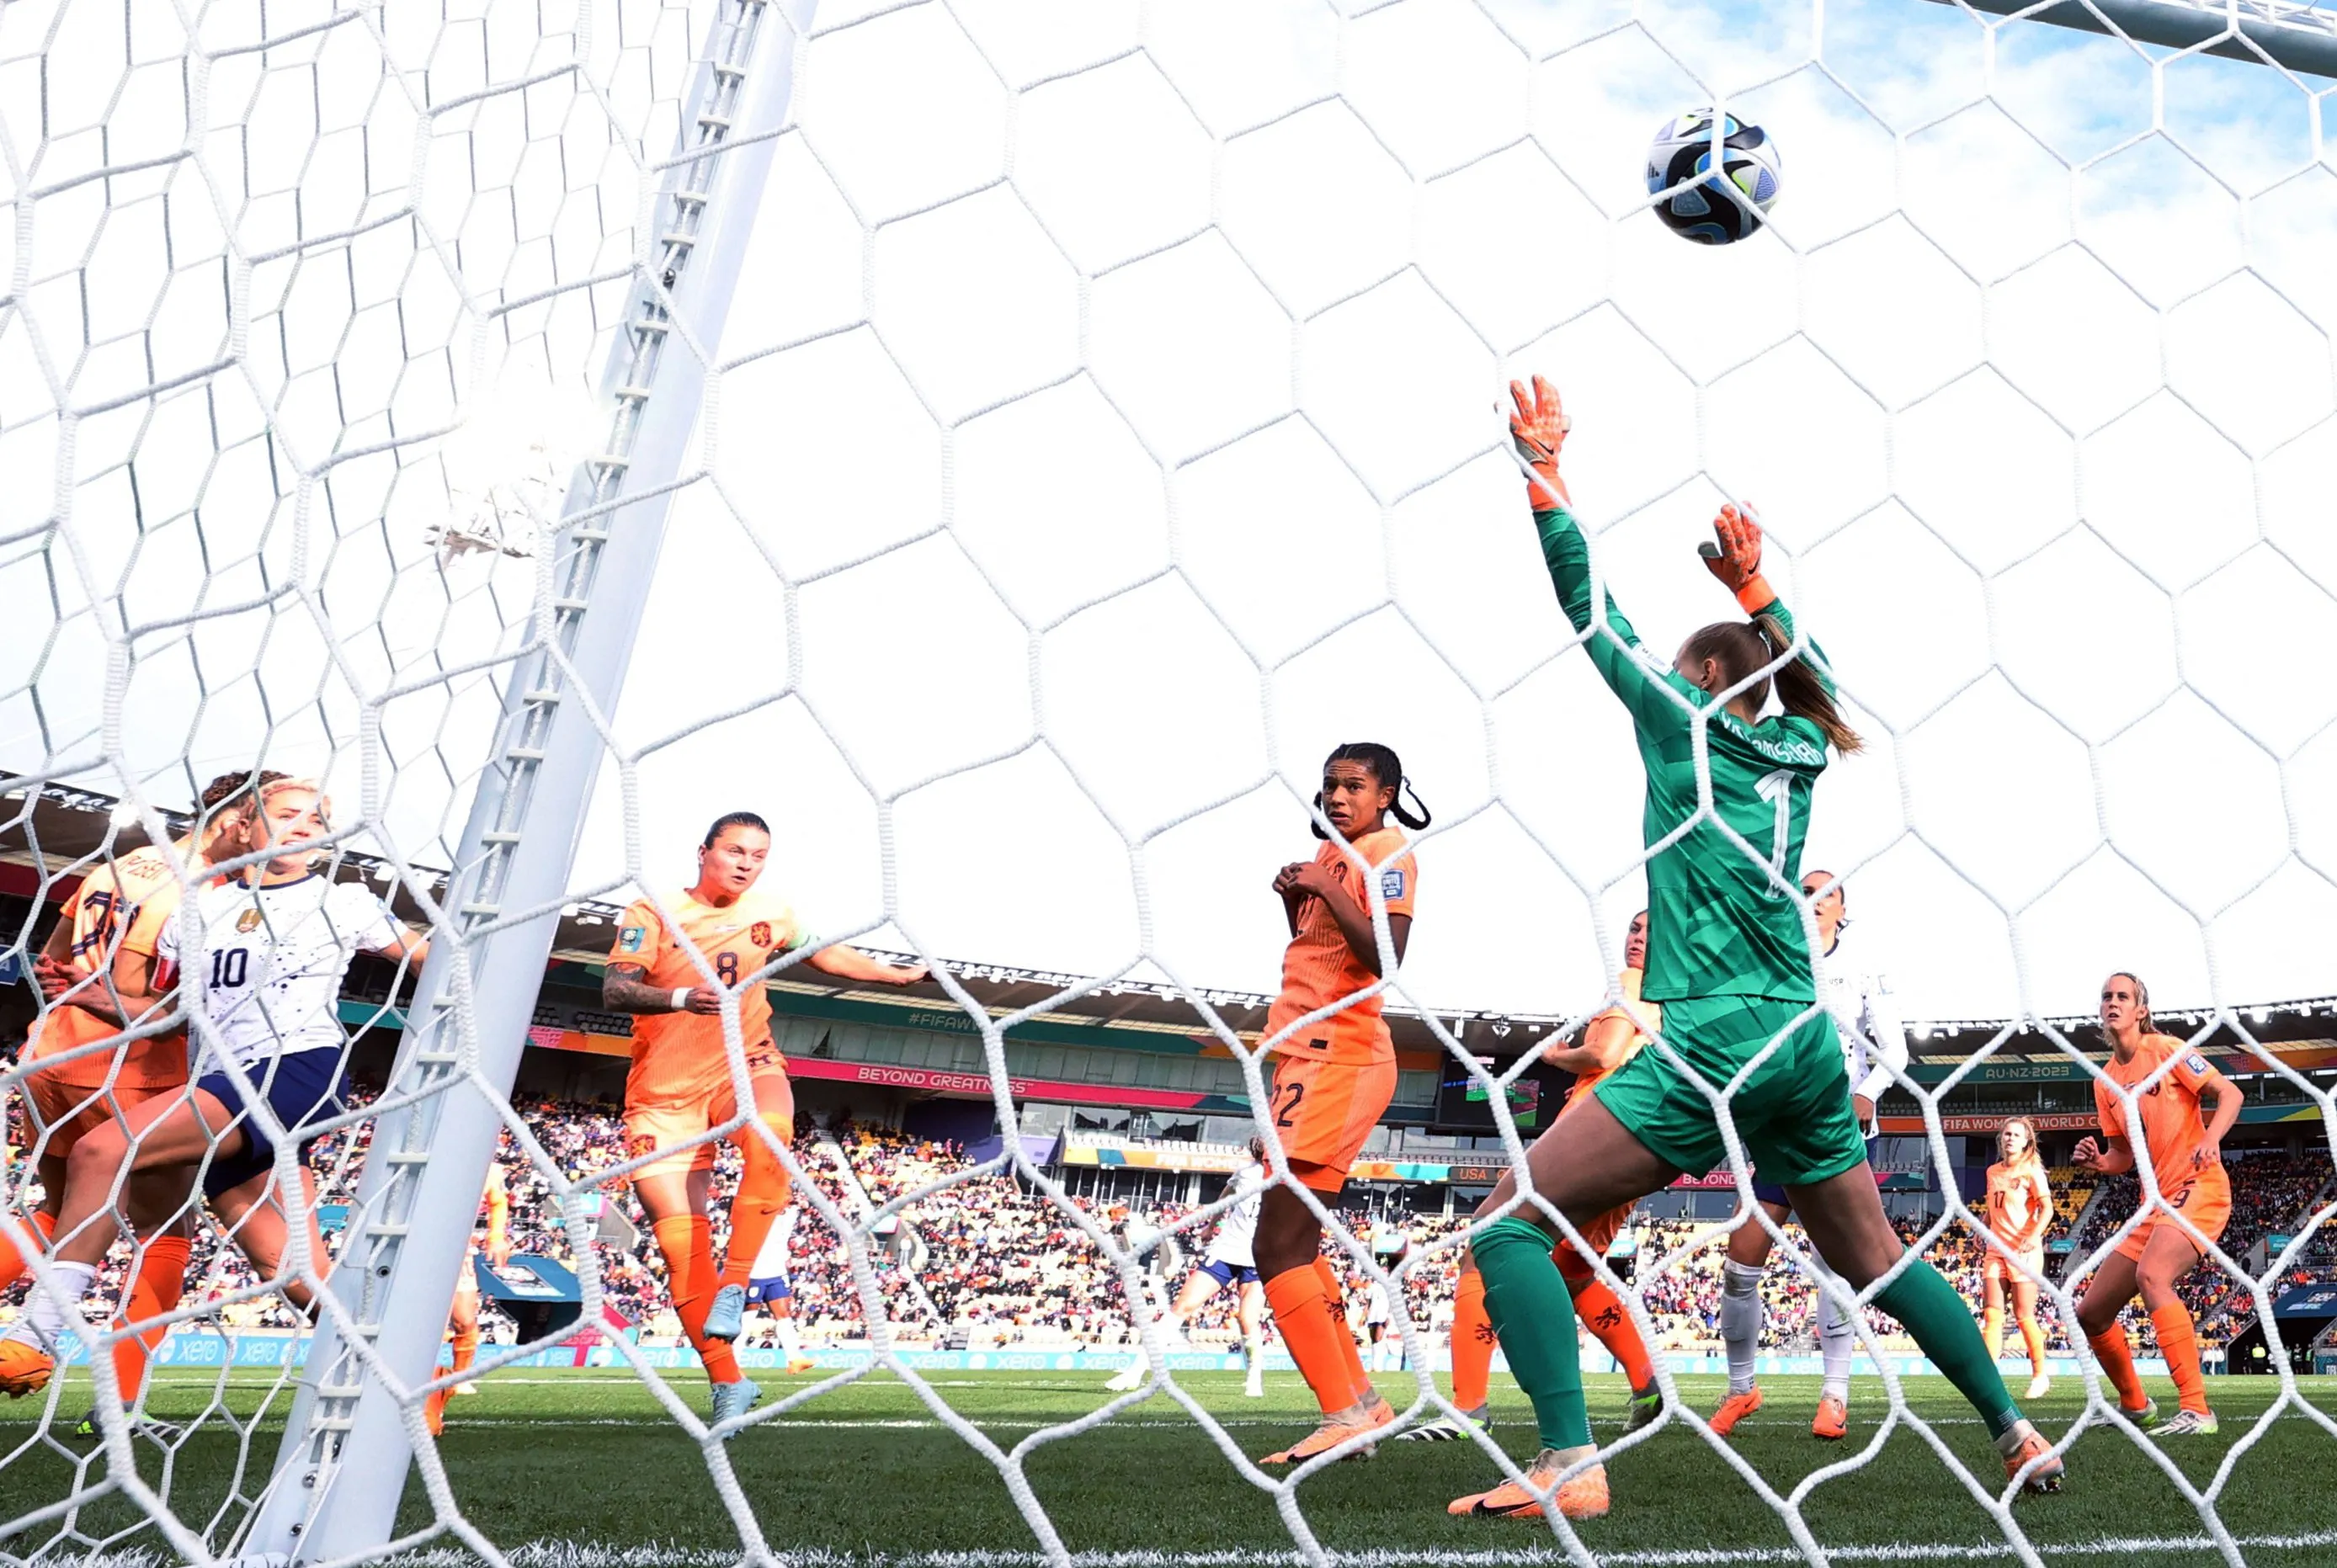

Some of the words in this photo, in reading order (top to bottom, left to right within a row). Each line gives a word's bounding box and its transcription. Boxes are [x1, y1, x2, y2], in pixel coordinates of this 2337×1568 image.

[1754, 768, 1796, 899] 1
[210, 948, 248, 988] 10
[716, 952, 737, 989] 8
[908, 1013, 977, 1030] #FIFAW
[858, 1067, 925, 1084] BEYOND
[930, 1074, 1025, 1093] GREATNSS
[1944, 1119, 1970, 1129] FIFA
[1972, 1118, 2035, 1129] WOMS
[2037, 1117, 2084, 1128] WORLD
[1460, 1168, 1487, 1180] USA
[1994, 1190, 2005, 1209] 17
[2173, 1188, 2191, 1209] 9
[177, 1340, 218, 1363] xero
[241, 1342, 278, 1363] xero
[740, 1351, 775, 1368] ero
[909, 1353, 961, 1369] xero
[995, 1354, 1046, 1369] xero
[1081, 1355, 1131, 1370] xero
[1168, 1356, 1216, 1370] xero
